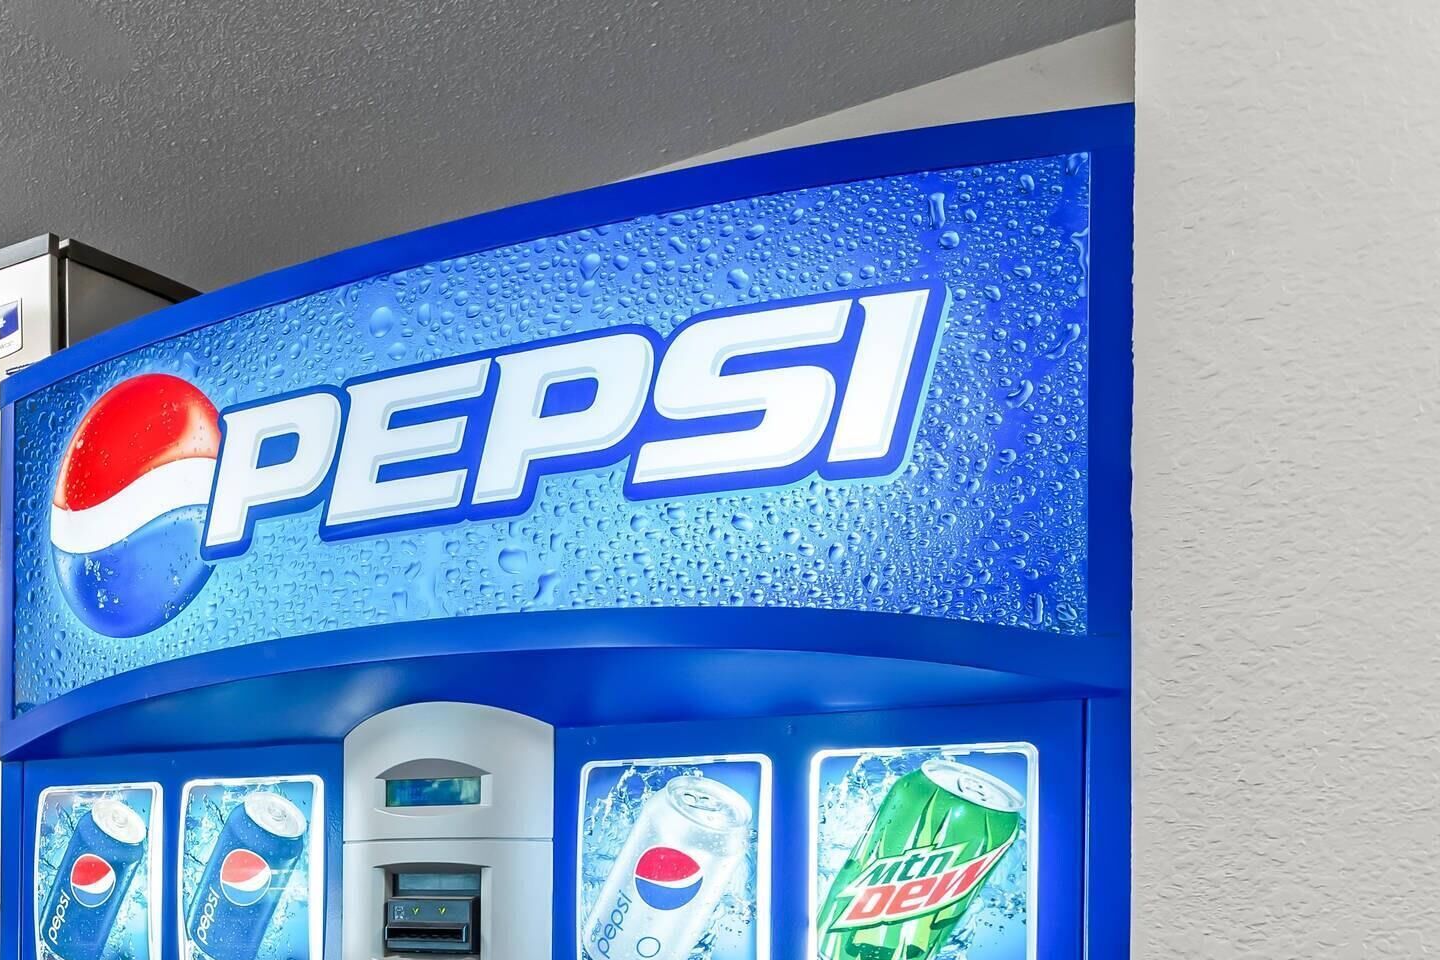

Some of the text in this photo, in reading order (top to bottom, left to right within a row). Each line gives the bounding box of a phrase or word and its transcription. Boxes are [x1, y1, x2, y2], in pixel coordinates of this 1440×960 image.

[205, 287, 931, 545] PEPSI
[48, 888, 70, 945] pepsi
[197, 886, 220, 945] pepsi
[597, 892, 632, 960] pepsi
